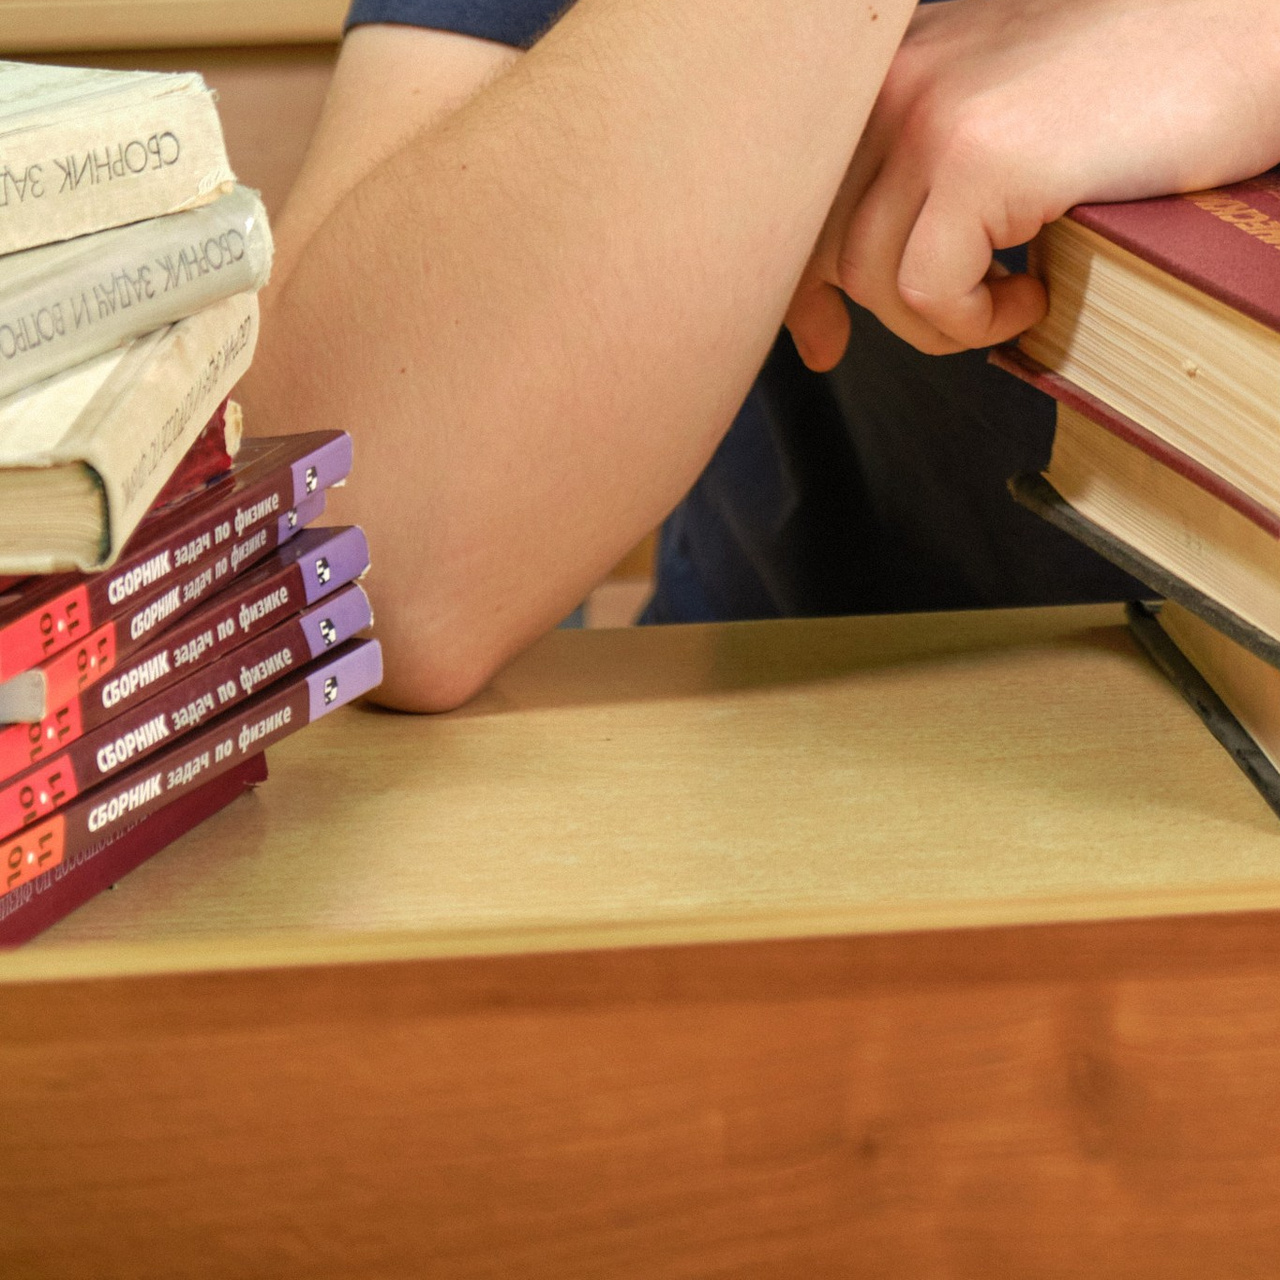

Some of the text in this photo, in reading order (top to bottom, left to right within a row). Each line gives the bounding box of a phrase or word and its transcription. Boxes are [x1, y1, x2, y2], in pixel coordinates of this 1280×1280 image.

[53, 131, 181, 193] СБОРНИК
[70, 294, 91, 330] И
[93, 265, 155, 320] ЗАДАЧ
[155, 228, 245, 291] СБОРНИК
[108, 492, 280, 605] СБОРНИК задач по физике
[130, 528, 267, 640] СБОРНИК задач по физике
[102, 585, 289, 709] СБОРНИК задач по физике
[96, 647, 293, 773] СБОРНИК задач по физике
[88, 772, 163, 832] СБОРНИК
[167, 750, 209, 790] задач
[215, 739, 233, 761] по
[238, 705, 292, 753] физике
